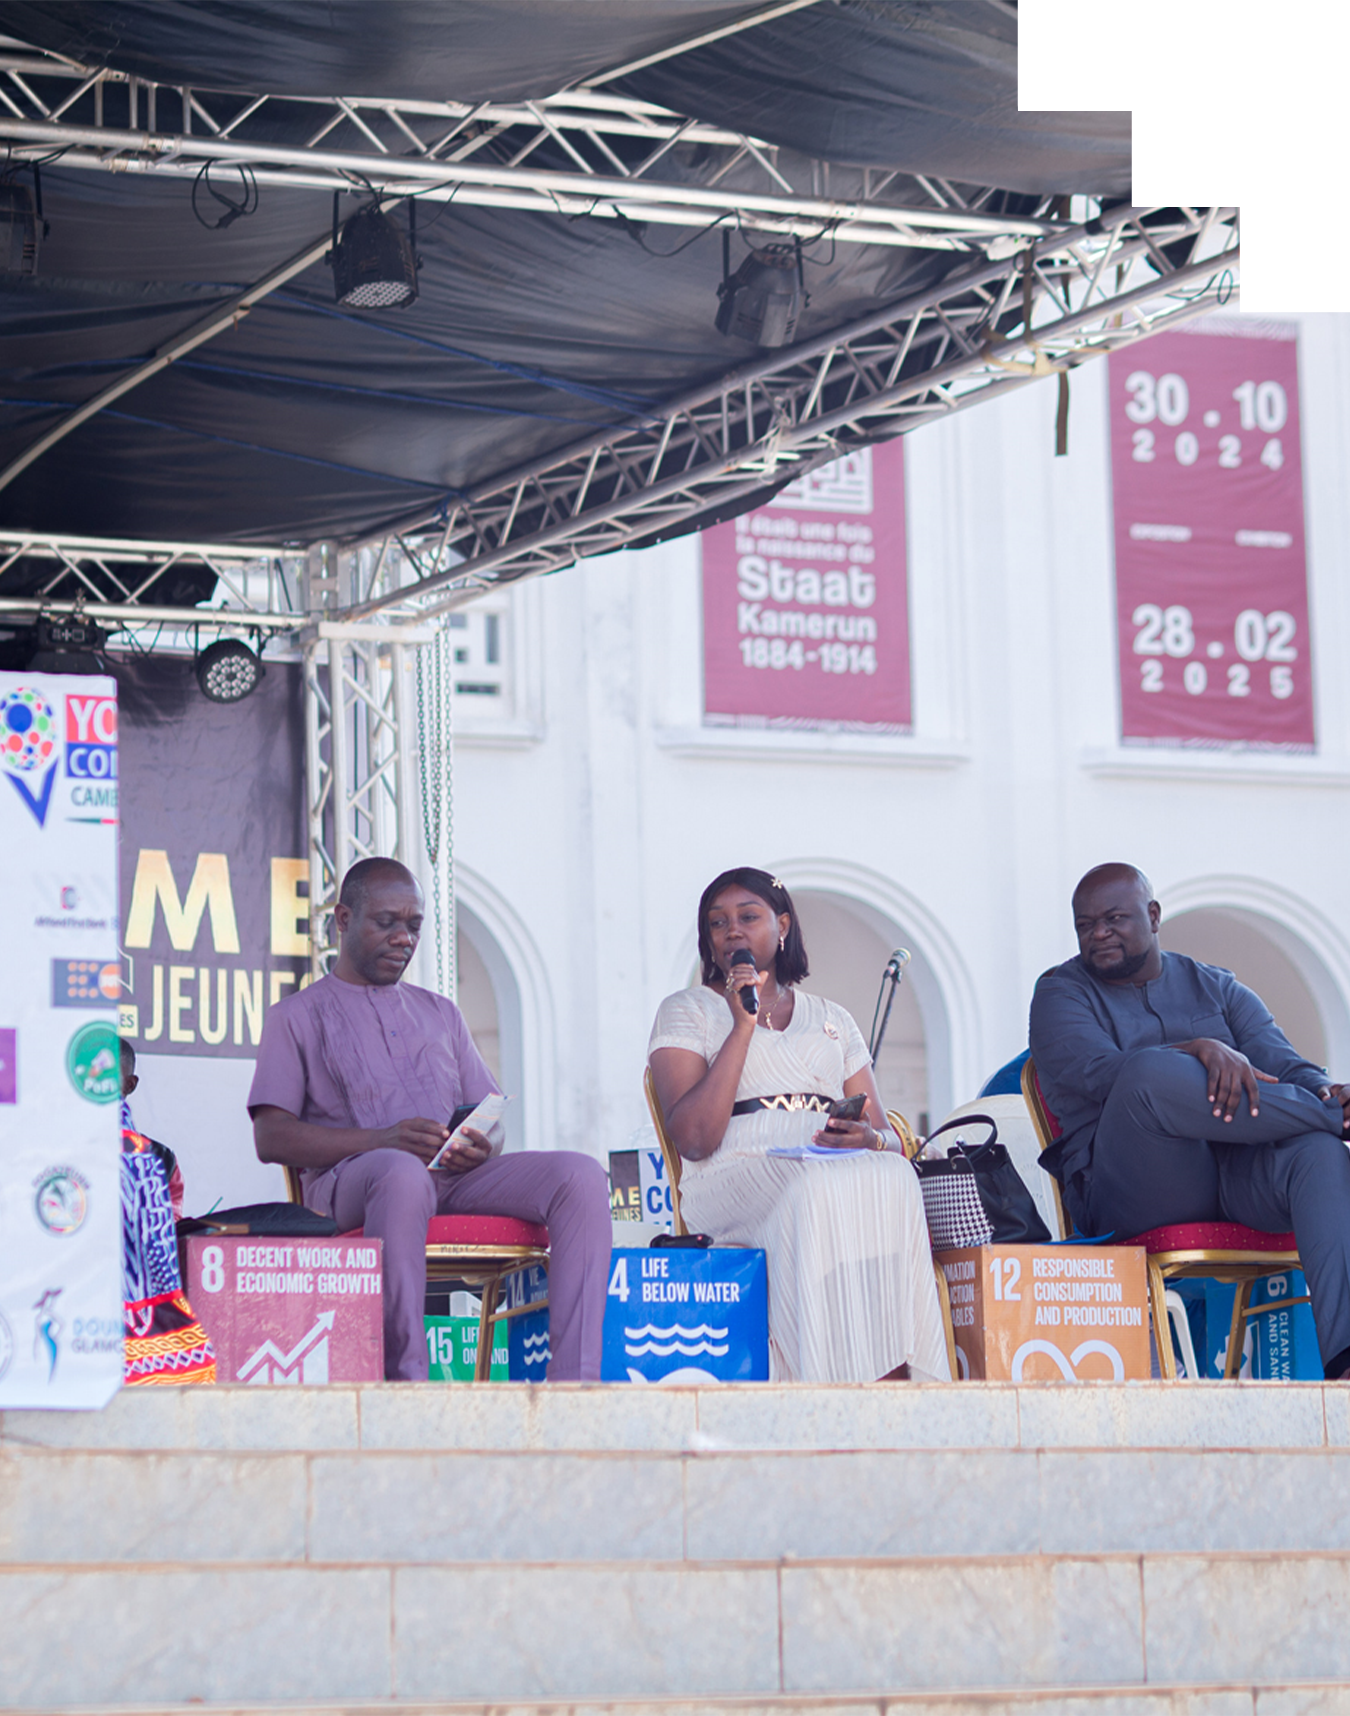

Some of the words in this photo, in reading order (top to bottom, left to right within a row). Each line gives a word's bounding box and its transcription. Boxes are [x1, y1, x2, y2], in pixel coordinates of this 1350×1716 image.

[737, 554, 876, 609] Staat
[737, 601, 878, 643] Kamerun
[739, 636, 878, 676] 1884-1914
[201, 1245, 225, 1293] 8
[236, 1246, 293, 1267] DECENT
[298, 1247, 341, 1268] WORK
[346, 1248, 376, 1269] AND
[642, 1258, 669, 1277] LIFE
[1033, 1258, 1115, 1278] RESPONSIBLE
[236, 1272, 313, 1293] ECONOMIC
[317, 1274, 381, 1294] GROWTH
[989, 1257, 1021, 1301] 12
[1034, 1282, 1122, 1302] CONSUMPTION
[1267, 1275, 1287, 1297] 6
[642, 1283, 689, 1302] BELOW
[693, 1283, 740, 1302] WATER
[1035, 1306, 1060, 1326] AND
[1064, 1306, 1142, 1326] PRODUCTION
[1268, 1313, 1278, 1343] AND
[426, 1326, 453, 1364] 15
[1279, 1312, 1289, 1357] CLEAN
